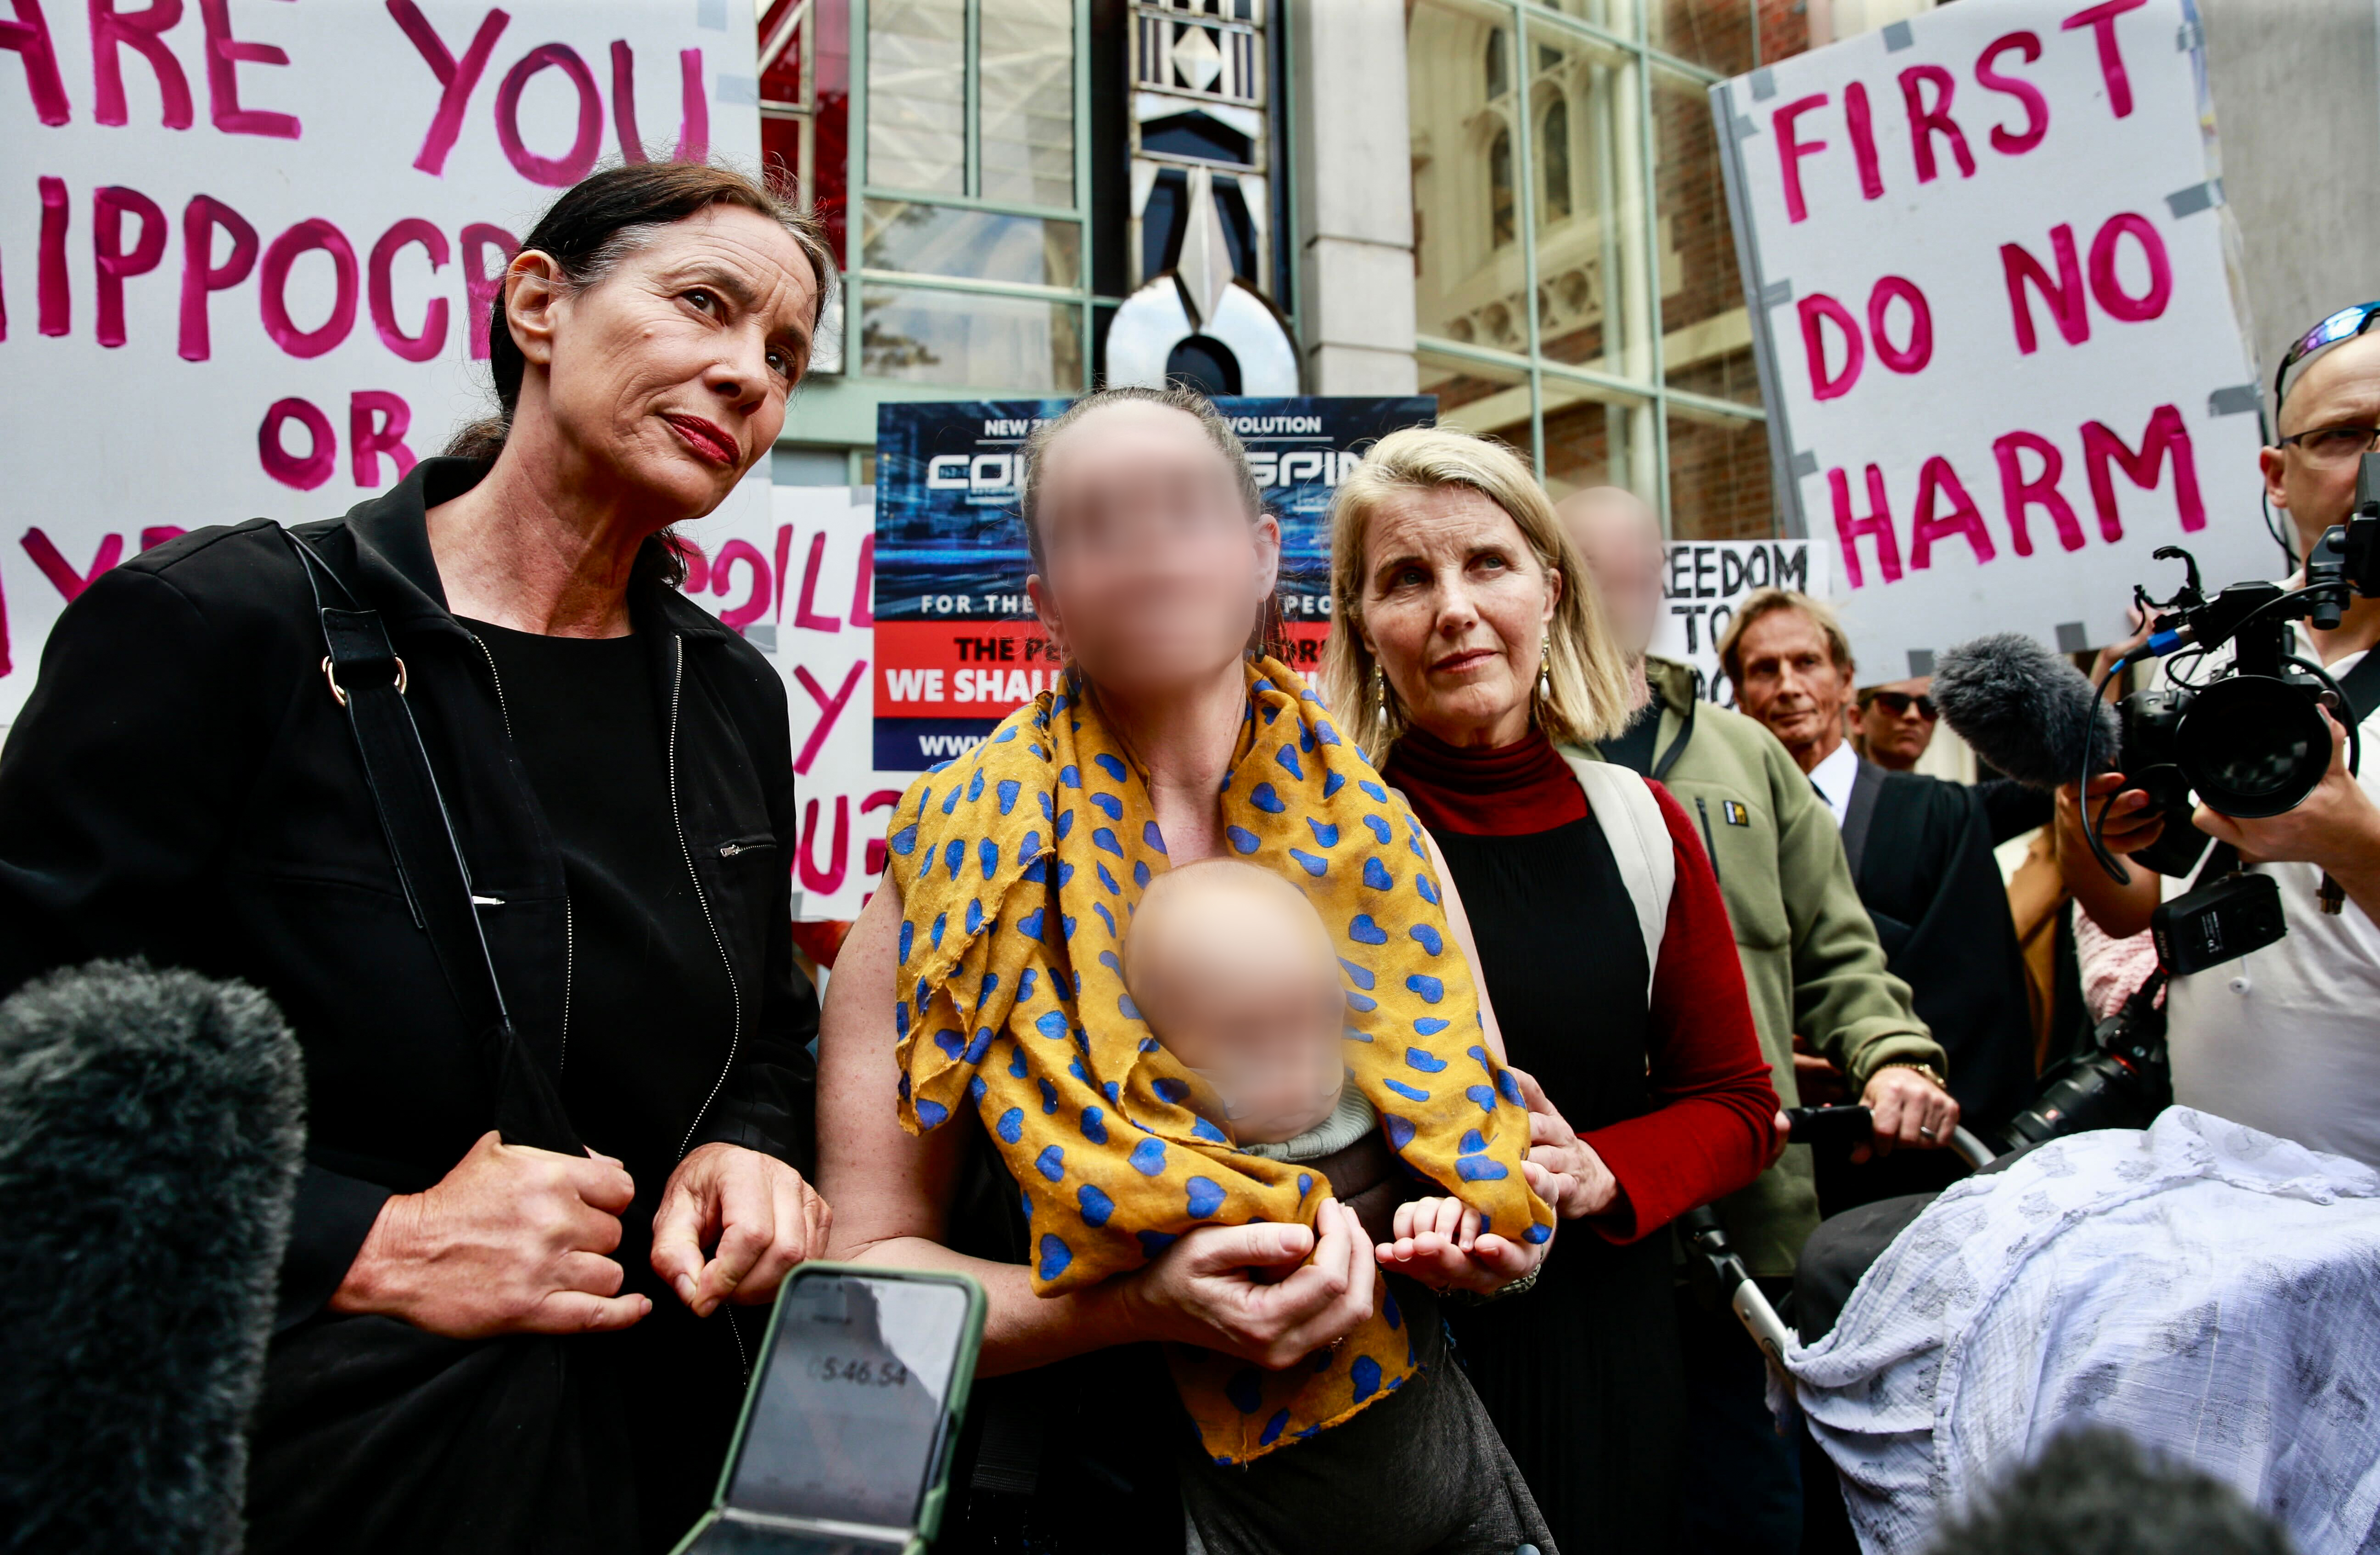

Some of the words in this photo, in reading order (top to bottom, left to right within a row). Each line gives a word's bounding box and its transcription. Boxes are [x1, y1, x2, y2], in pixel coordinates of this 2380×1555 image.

[387, 0, 710, 186] YOU
[1772, 0, 2147, 224] FIRST
[1796, 275, 1934, 402] DO
[1999, 212, 2174, 355] NO
[259, 390, 419, 492] OR
[984, 419, 1028, 436] NEW
[927, 454, 1027, 490] CO
[1826, 404, 2207, 589] HARM
[921, 595, 971, 614] FOR
[984, 594, 1035, 614] THE
[954, 637, 1015, 661] THE
[885, 669, 944, 702] WE
